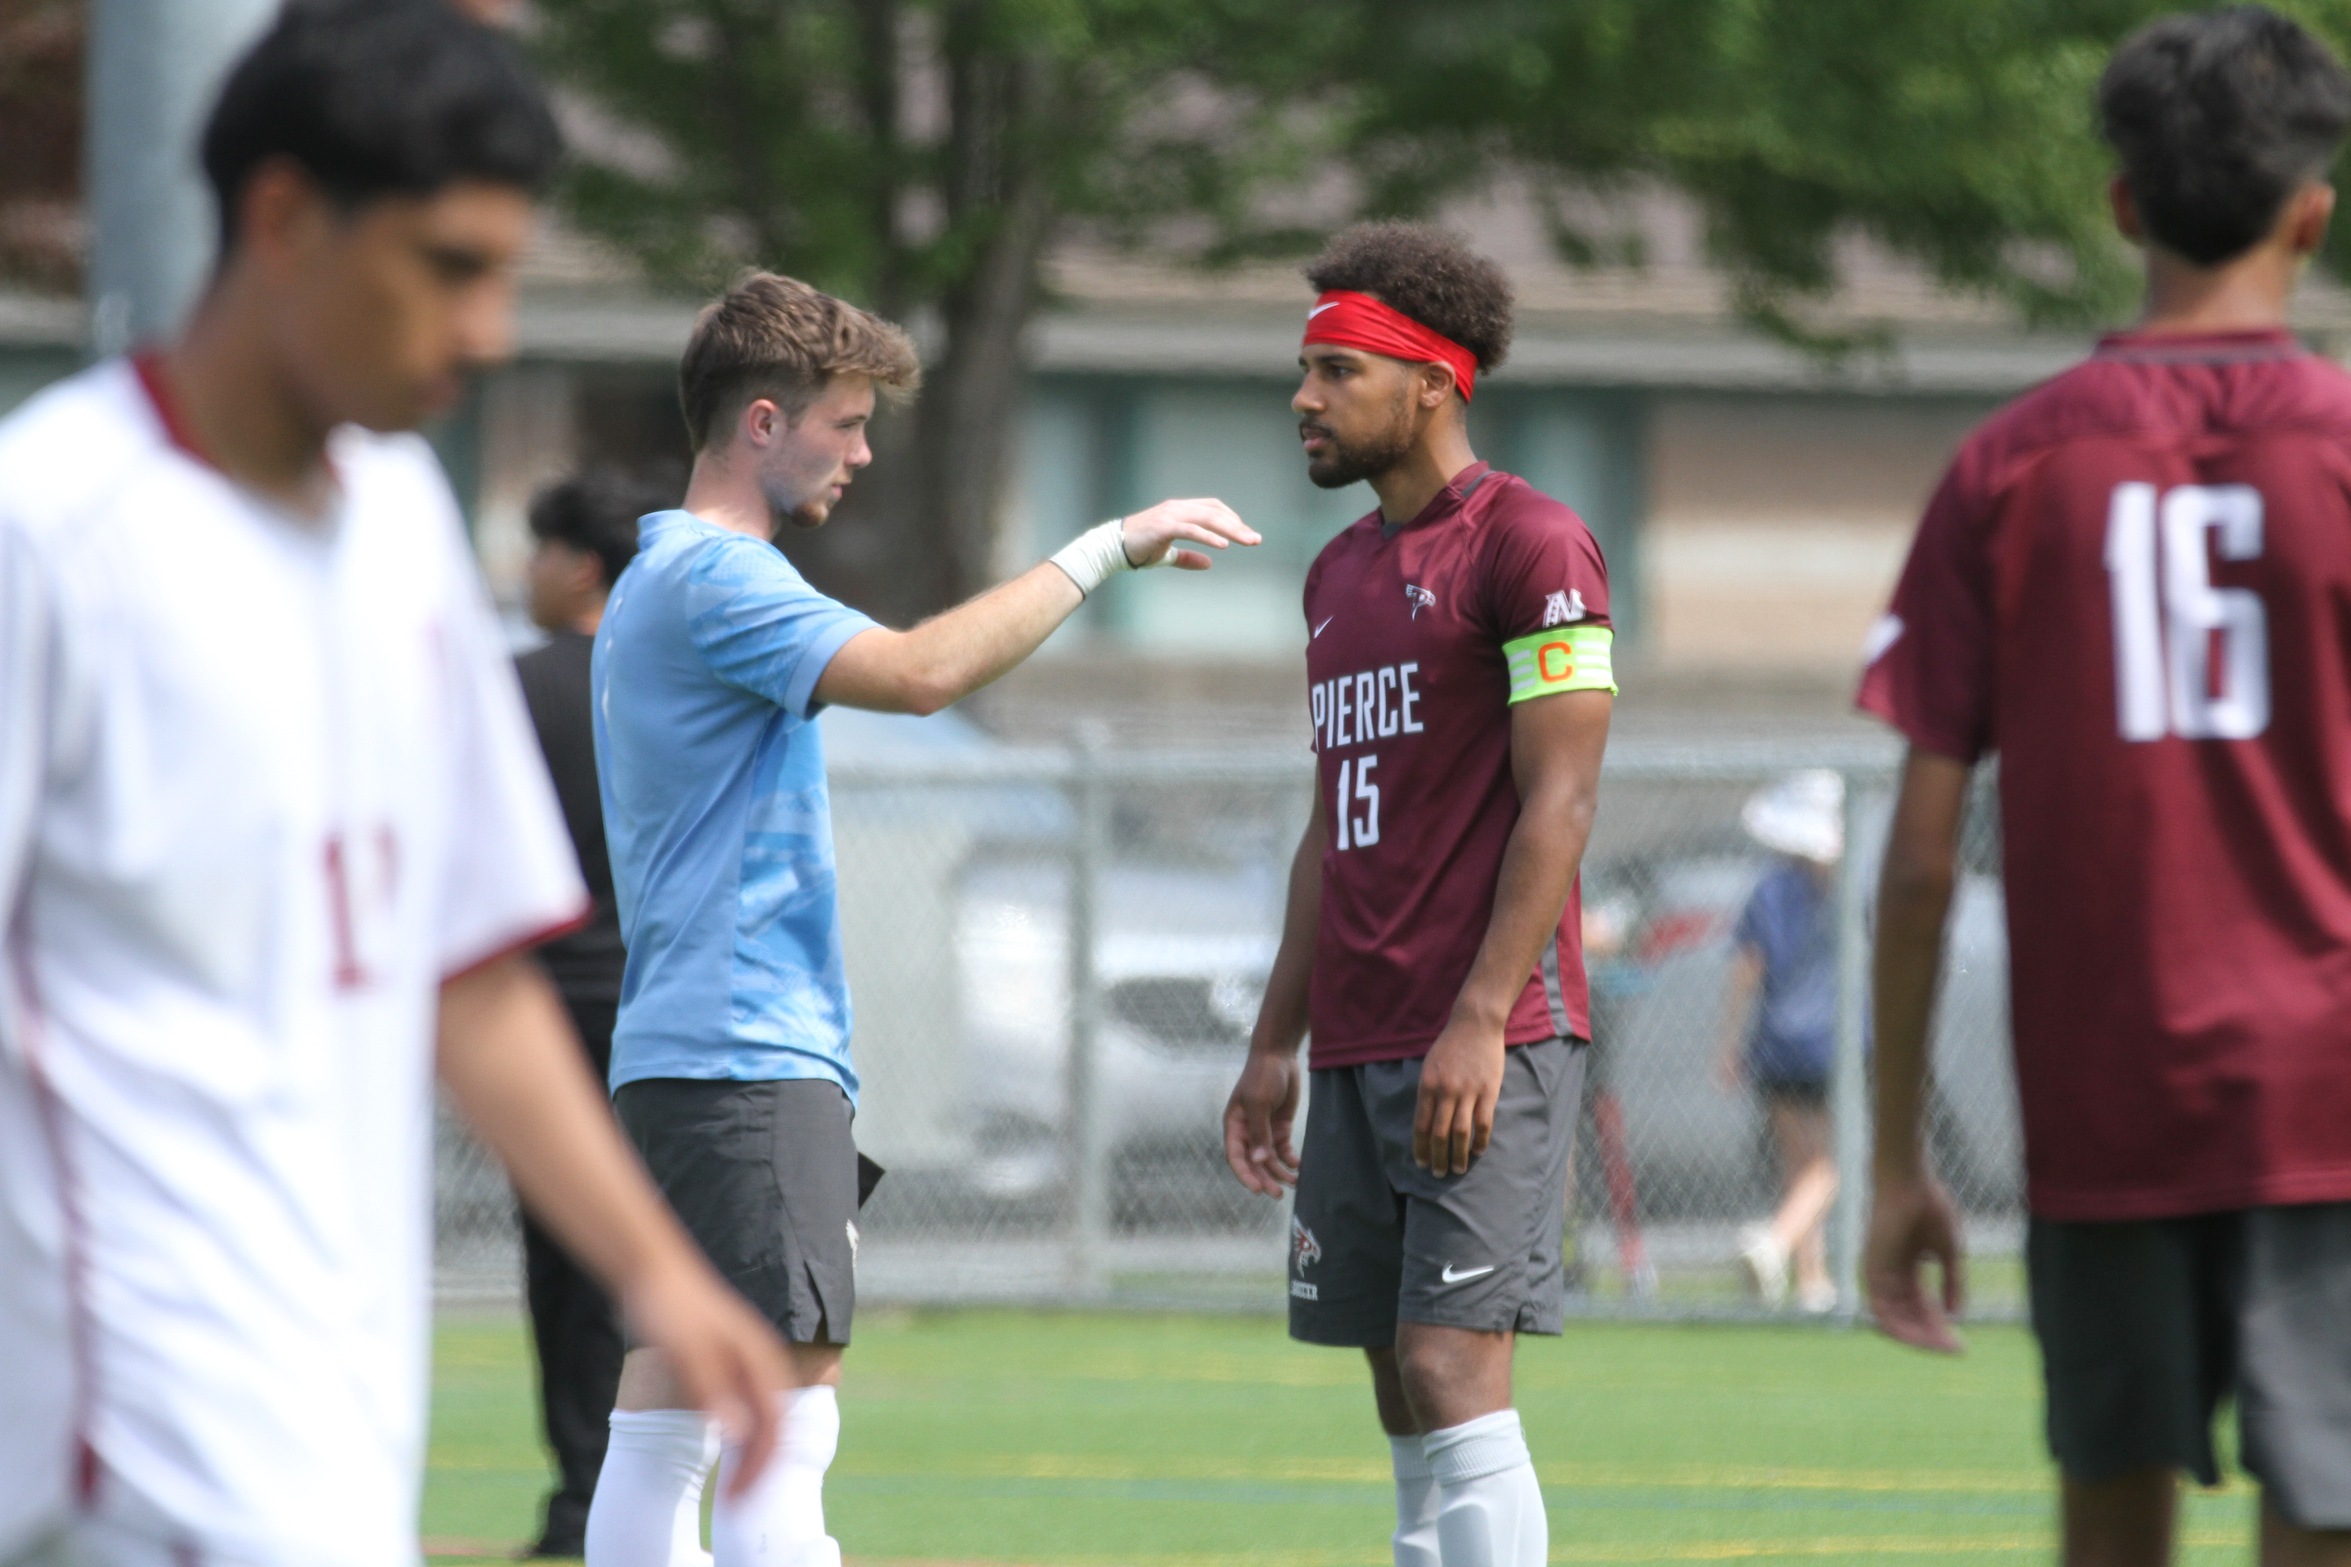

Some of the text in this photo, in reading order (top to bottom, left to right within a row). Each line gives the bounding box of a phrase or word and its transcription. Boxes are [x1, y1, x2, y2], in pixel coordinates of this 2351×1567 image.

[2103, 480, 2272, 743] 16
[1312, 662, 1424, 753] PIERCE
[1538, 641, 1573, 683] C
[1337, 754, 1380, 851] 15
